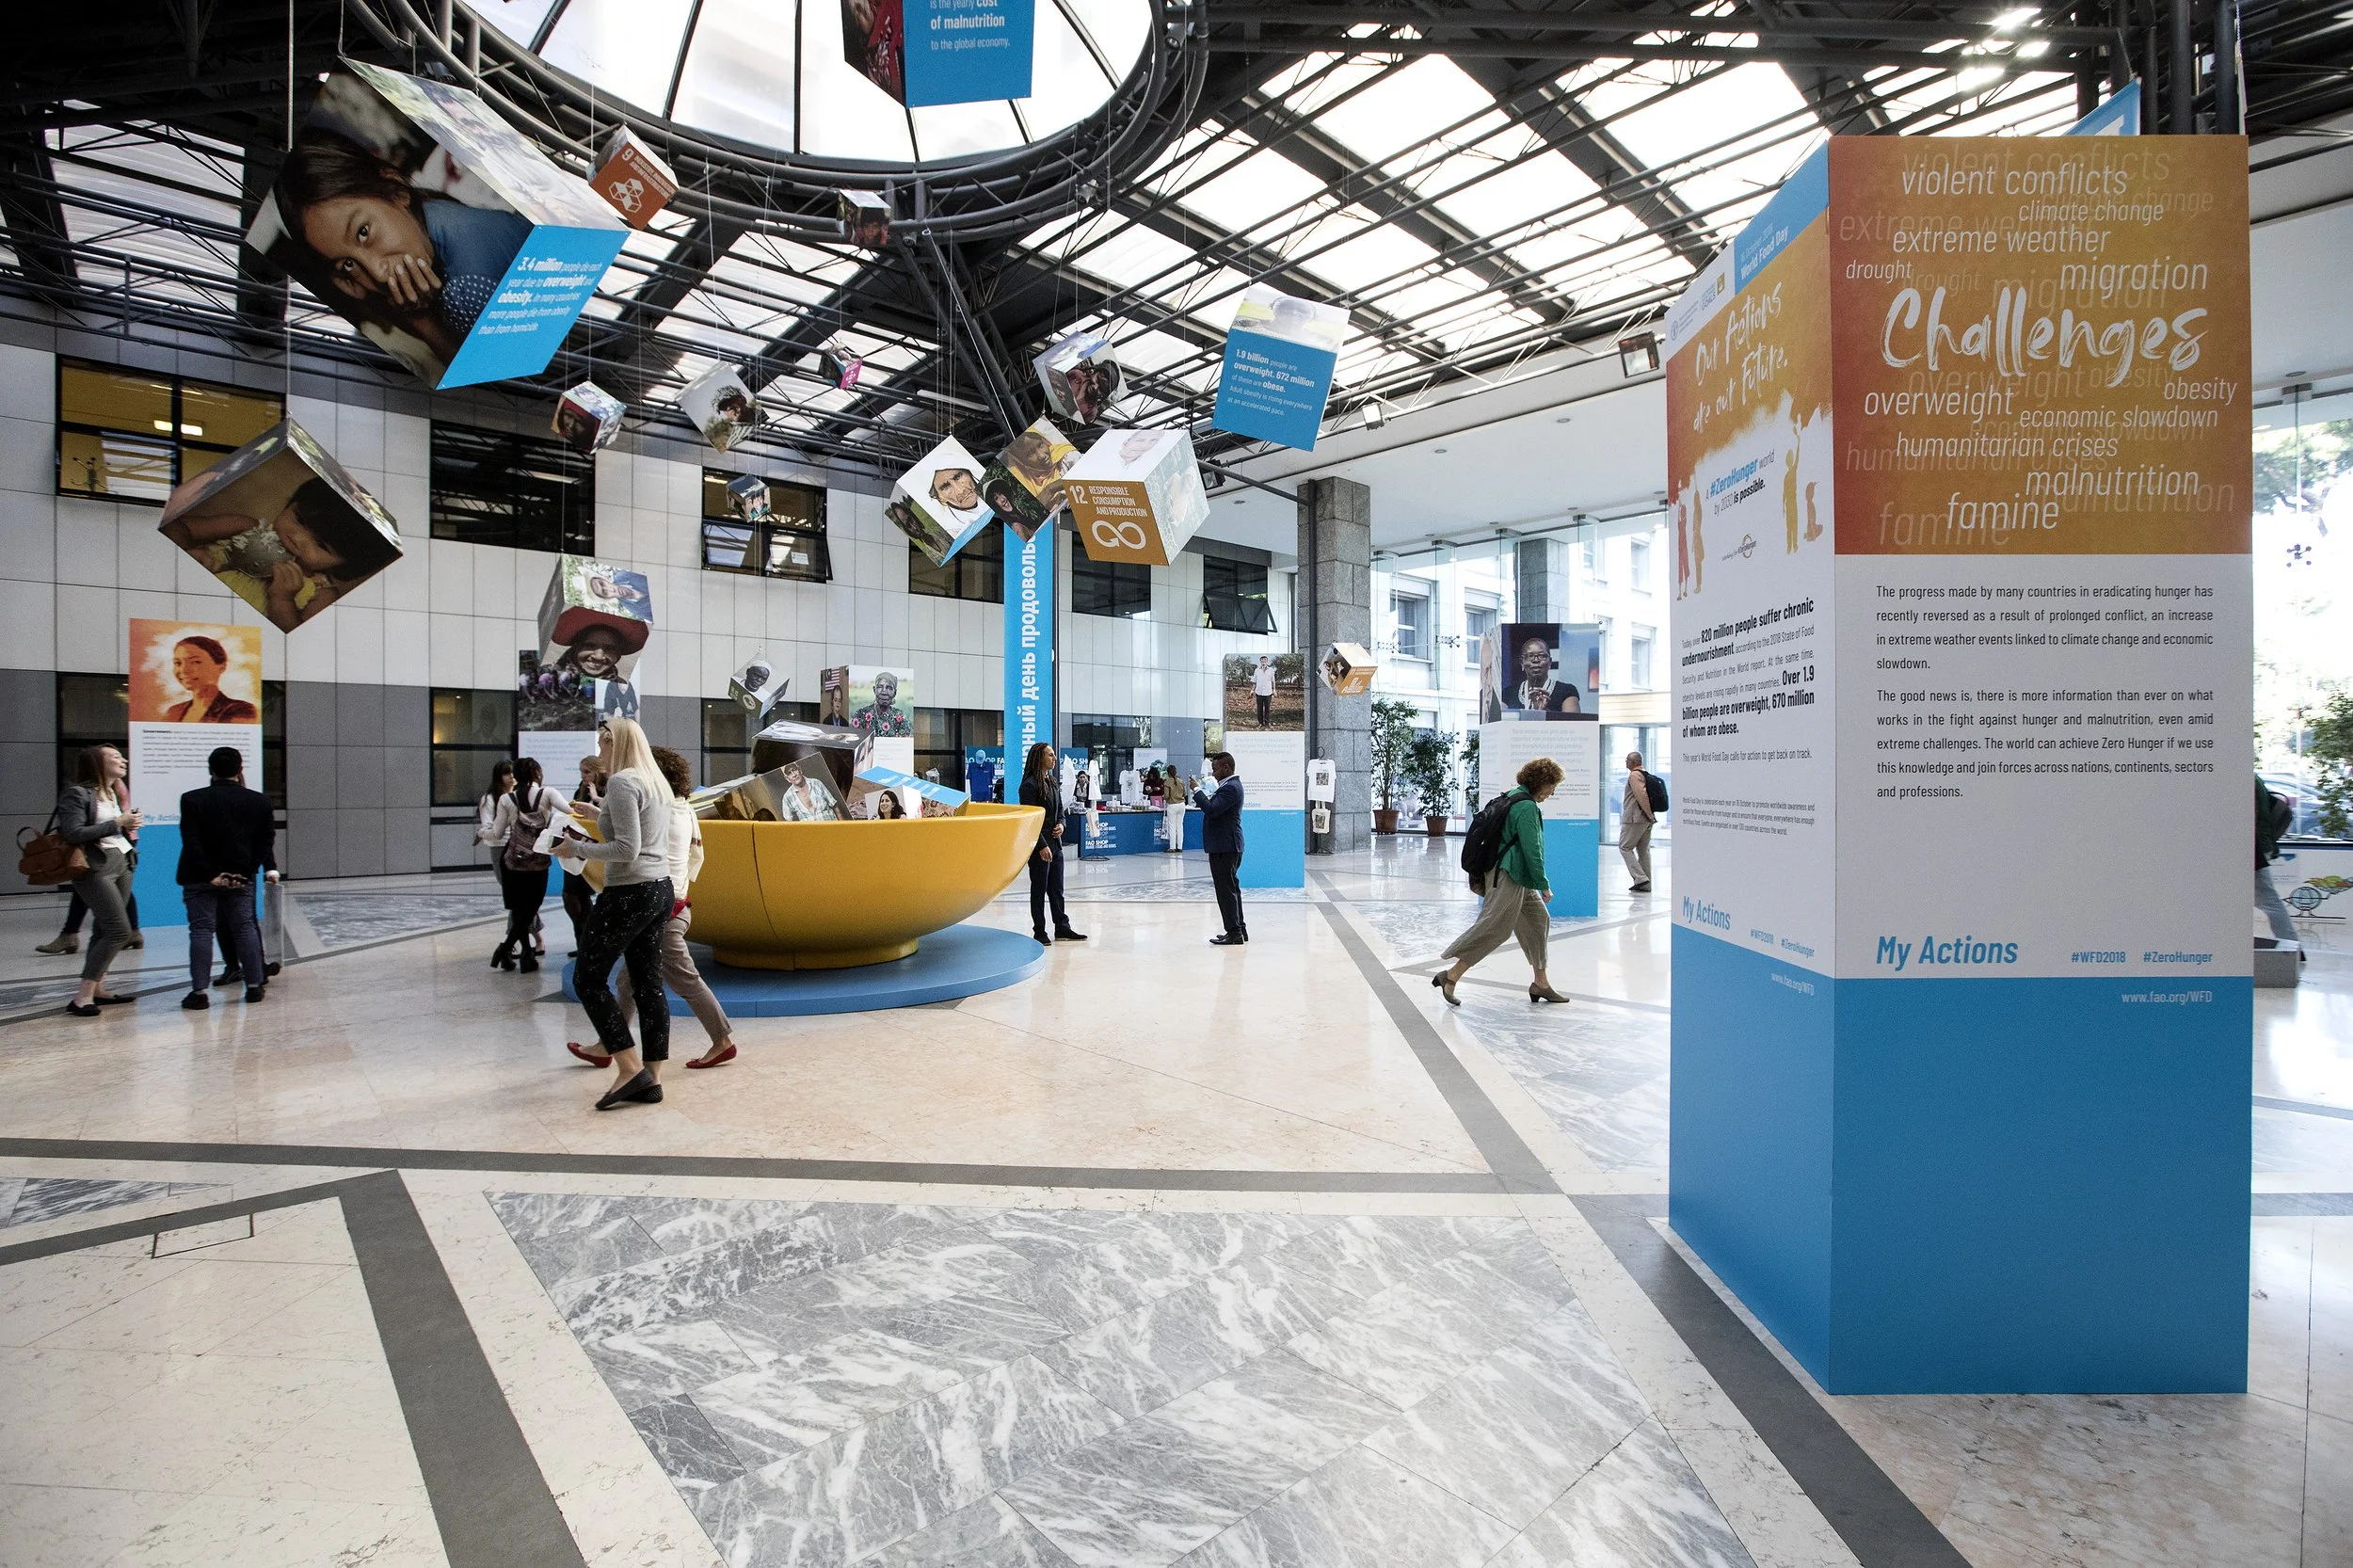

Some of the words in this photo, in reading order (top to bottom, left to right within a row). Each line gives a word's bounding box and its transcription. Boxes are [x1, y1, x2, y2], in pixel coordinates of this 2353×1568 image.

[930, 15, 941, 30] of
[944, 13, 1005, 29] malnutrition
[1901, 163, 1995, 195] violent
[2008, 163, 2128, 195] conflicts
[2018, 200, 2089, 222] climate
[2094, 201, 2165, 226] change
[1892, 226, 1996, 252] extreme
[2007, 225, 2111, 252] weather
[518, 257, 536, 271] 3.4
[534, 257, 563, 271] million
[1740, 251, 1758, 280] World
[1758, 238, 1775, 264] Food
[1775, 226, 1788, 246] Day
[542, 274, 586, 289] overweight
[1846, 259, 1912, 284] drought
[2058, 255, 2209, 299] migration
[1696, 338, 1720, 386] Our
[1725, 282, 1783, 365] Actions
[1880, 286, 2209, 388] Challenges
[1236, 348, 1246, 359] 1.9
[1247, 351, 1270, 364] billion
[1233, 361, 1275, 378] overweight.
[1276, 371, 1289, 381] 672
[1289, 375, 1315, 388] million
[1262, 381, 1287, 392] obese.
[1693, 402, 1711, 433] are
[1716, 377, 1736, 415] our
[1741, 342, 1788, 406] Future.
[2164, 376, 2237, 405] obesity
[1864, 387, 2013, 424] overweight
[2019, 406, 2118, 428] economic
[2122, 405, 2219, 428] slowdown
[1896, 432, 2043, 456] humanitarian
[2052, 433, 2119, 457] crises
[1710, 458, 1758, 497] #ZeroHunger
[2025, 463, 2200, 496] malnutrition
[1069, 485, 1088, 504] 12
[1088, 486, 1129, 496] RESPONSIBLE
[1092, 496, 1136, 506] CONSUMPTION
[1733, 491, 1739, 504] is
[1739, 477, 1766, 504] possible.
[1096, 506, 1109, 516] AND
[1109, 507, 1147, 517] PRODUCTION
[1946, 491, 2059, 529] famine
[1876, 585, 1896, 598] The
[1898, 587, 1945, 600] progress
[1948, 585, 1977, 598] made
[1980, 585, 1993, 600] by
[1995, 587, 2025, 600] many
[2027, 585, 2077, 598] countries
[2079, 584, 2089, 598] in
[2092, 584, 2152, 600] eradicating
[2154, 584, 2192, 600] hunger
[2194, 584, 2214, 598] has
[1701, 628, 1712, 643] 820
[1713, 623, 1734, 640] million
[1735, 615, 1757, 637] people
[1758, 608, 1782, 627] suffer
[1783, 597, 1814, 620] chronic
[1876, 609, 1919, 625] recently
[1923, 609, 1969, 622] reversed
[1973, 612, 1986, 621] as
[1989, 612, 1996, 621] a
[2000, 609, 2030, 621] result
[2034, 609, 2045, 621] of
[2049, 609, 2101, 625] prolonged
[2105, 609, 2148, 622] conflict,
[2151, 611, 2165, 621] an
[2168, 609, 2214, 621] increase
[1876, 632, 1886, 646] in
[1888, 634, 1931, 646] extreme
[1933, 632, 1977, 646] weather
[1978, 634, 2013, 646] events
[2015, 632, 2046, 646] linked
[2048, 633, 2059, 646] to
[2060, 632, 2100, 646] climate
[2101, 632, 2139, 648] change
[2141, 632, 2161, 646] and
[2163, 632, 2214, 646] economic
[1682, 642, 1734, 666] undernourishment
[1876, 657, 1930, 669] slowdown.
[1021, 652, 1039, 700] день
[1782, 669, 1801, 685] Over
[1802, 664, 1815, 682] 1.9
[1682, 706, 1699, 720] billion
[1699, 703, 1719, 721] people
[1719, 703, 1730, 715] are
[1731, 696, 1770, 714] overweight,
[1772, 692, 1786, 709] 670
[1787, 689, 1815, 707] million
[1877, 689, 1897, 702] The
[1899, 689, 1926, 705] good
[1929, 692, 1958, 702] news
[1961, 689, 1973, 702] is,
[1977, 689, 2005, 702] there
[2009, 689, 2018, 702] is
[2021, 692, 2049, 702] more
[2052, 689, 2113, 701] information
[2116, 689, 2140, 701] than
[2144, 692, 2168, 701] ever
[2170, 691, 2185, 701] on
[2187, 689, 2214, 701] what
[1682, 725, 1689, 738] of
[1689, 725, 1705, 737] whom
[1706, 725, 1717, 736] are
[1718, 721, 1739, 735] obese.
[1877, 713, 1909, 726] works
[1913, 713, 1923, 726] in
[1928, 713, 1945, 726] the
[1949, 713, 1975, 728] fight
[1978, 713, 2017, 728] against
[2022, 713, 2058, 728] hunger
[2062, 712, 2082, 726] and
[2087, 712, 2153, 726] malnutrition,
[2158, 715, 2184, 726] even
[2187, 712, 2214, 725] amid
[1877, 739, 1920, 750] extreme
[1923, 737, 1981, 753] challenges.
[1983, 737, 2004, 749] The
[2006, 737, 2035, 750] world
[2037, 740, 2057, 749] can
[2058, 737, 2100, 749] achieve
[2101, 736, 2125, 749] Zero
[2127, 737, 2165, 752] Hunger
[2167, 736, 2175, 749] if
[2177, 739, 2192, 749] we
[2195, 739, 2214, 749] use
[1877, 761, 1897, 774] this
[1898, 761, 1954, 776] knowledge
[1956, 761, 1976, 774] and
[1977, 760, 1996, 776] join
[1998, 760, 2032, 774] forces
[2033, 763, 2070, 774] across
[2071, 760, 2113, 774] nations,
[2114, 760, 2172, 774] continents,
[2174, 761, 2215, 773] sectors
[1877, 785, 1897, 798] and
[1899, 785, 1963, 801] professions.
[1683, 895, 1694, 923] My
[1696, 900, 1731, 930] Actions
[1876, 936, 1913, 972] My
[1917, 935, 2019, 965] Actions
[2071, 951, 2126, 964] #WFD2018
[2143, 951, 2214, 966] #ZeroHunger
[2121, 990, 2213, 1006] www.fao.org/WFD
